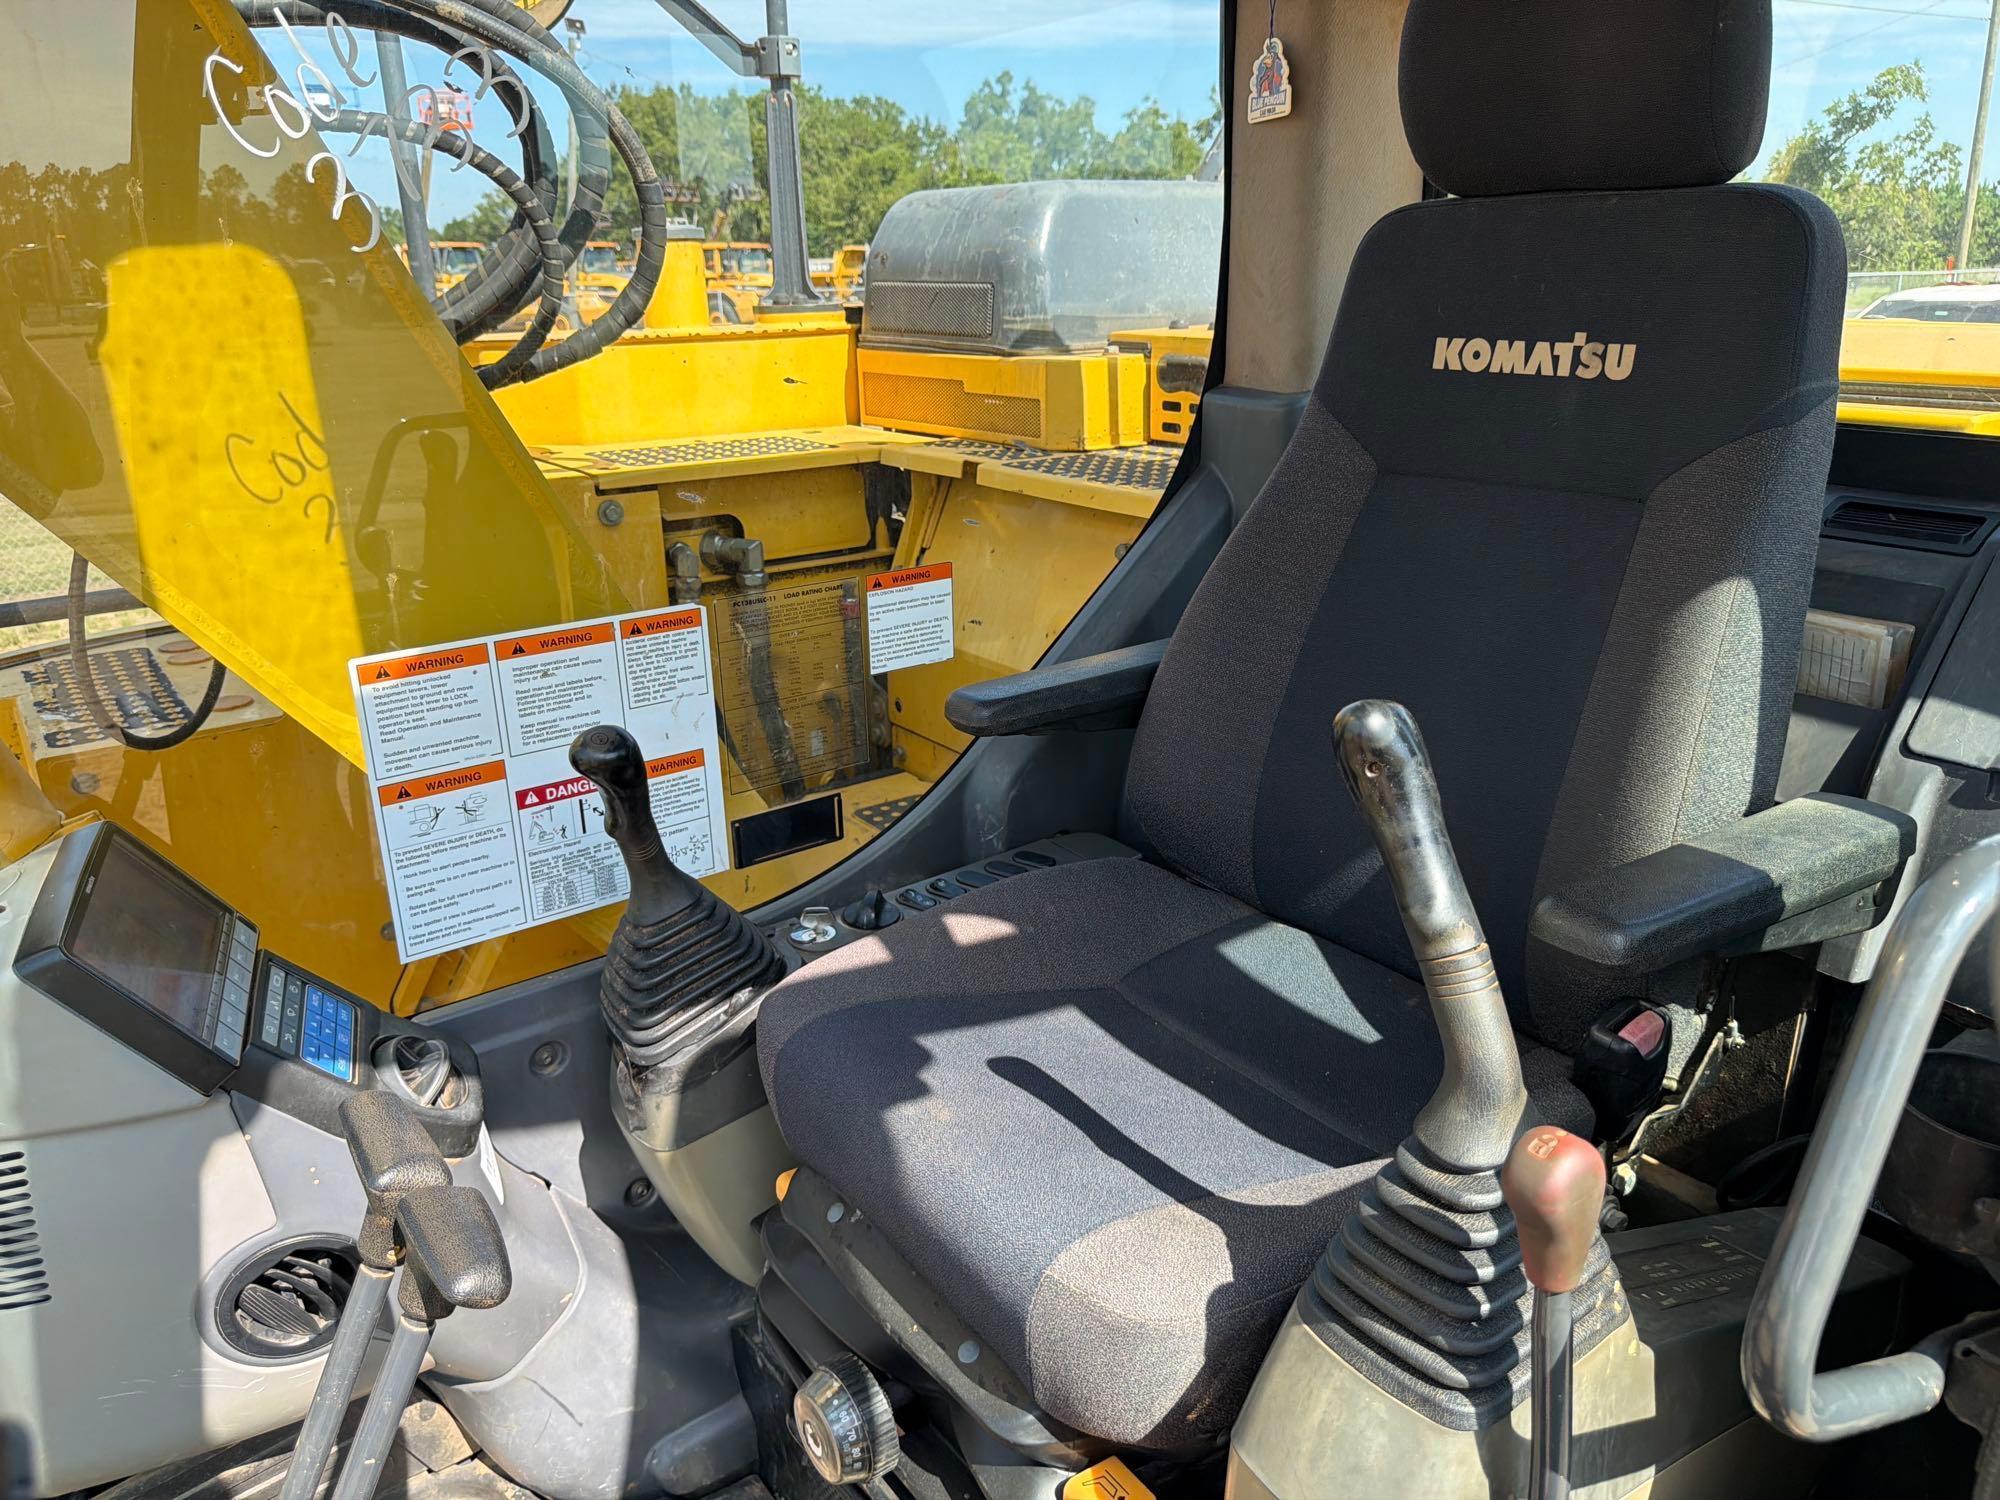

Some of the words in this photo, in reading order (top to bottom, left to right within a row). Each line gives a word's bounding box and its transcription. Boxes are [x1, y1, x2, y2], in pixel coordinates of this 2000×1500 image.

[204, 7, 377, 158] Code
[1432, 332, 1637, 381] KOMATSU
[891, 570, 930, 583] WARNING
[783, 591, 800, 599] LOAD
[801, 587, 823, 596] RATING
[824, 584, 842, 593] CHART
[645, 615, 693, 631] WARNING
[539, 632, 592, 648] WARNING
[406, 654, 464, 672] WARNING
[372, 689, 407, 701] equipment
[430, 681, 448, 689] lower
[381, 683, 399, 691] avoid
[400, 679, 421, 688] hitting
[421, 673, 451, 683] unlocked
[374, 695, 410, 707] attachment
[418, 690, 442, 700] ground
[375, 703, 409, 715] equipment
[410, 700, 424, 708] lock
[424, 697, 441, 705] lever
[449, 692, 468, 700] LOCK
[376, 712, 403, 722] position
[403, 708, 424, 716] before
[425, 702, 453, 713] standing
[463, 697, 478, 705] from
[378, 718, 410, 730] operator's
[379, 728, 396, 736] Read
[396, 722, 428, 734] Operation
[442, 712, 481, 724] Maintenance
[383, 748, 407, 758] Sudden
[421, 739, 452, 751] unwanted
[453, 734, 479, 744] machine
[384, 753, 417, 765] movement
[450, 742, 473, 751] serious
[474, 738, 492, 747] injury
[649, 755, 696, 773] WARNING
[425, 771, 482, 791] WARNING
[544, 780, 597, 800] DANGE
[668, 825, 688, 836] pattern
[846, 1428, 857, 1442] 70
